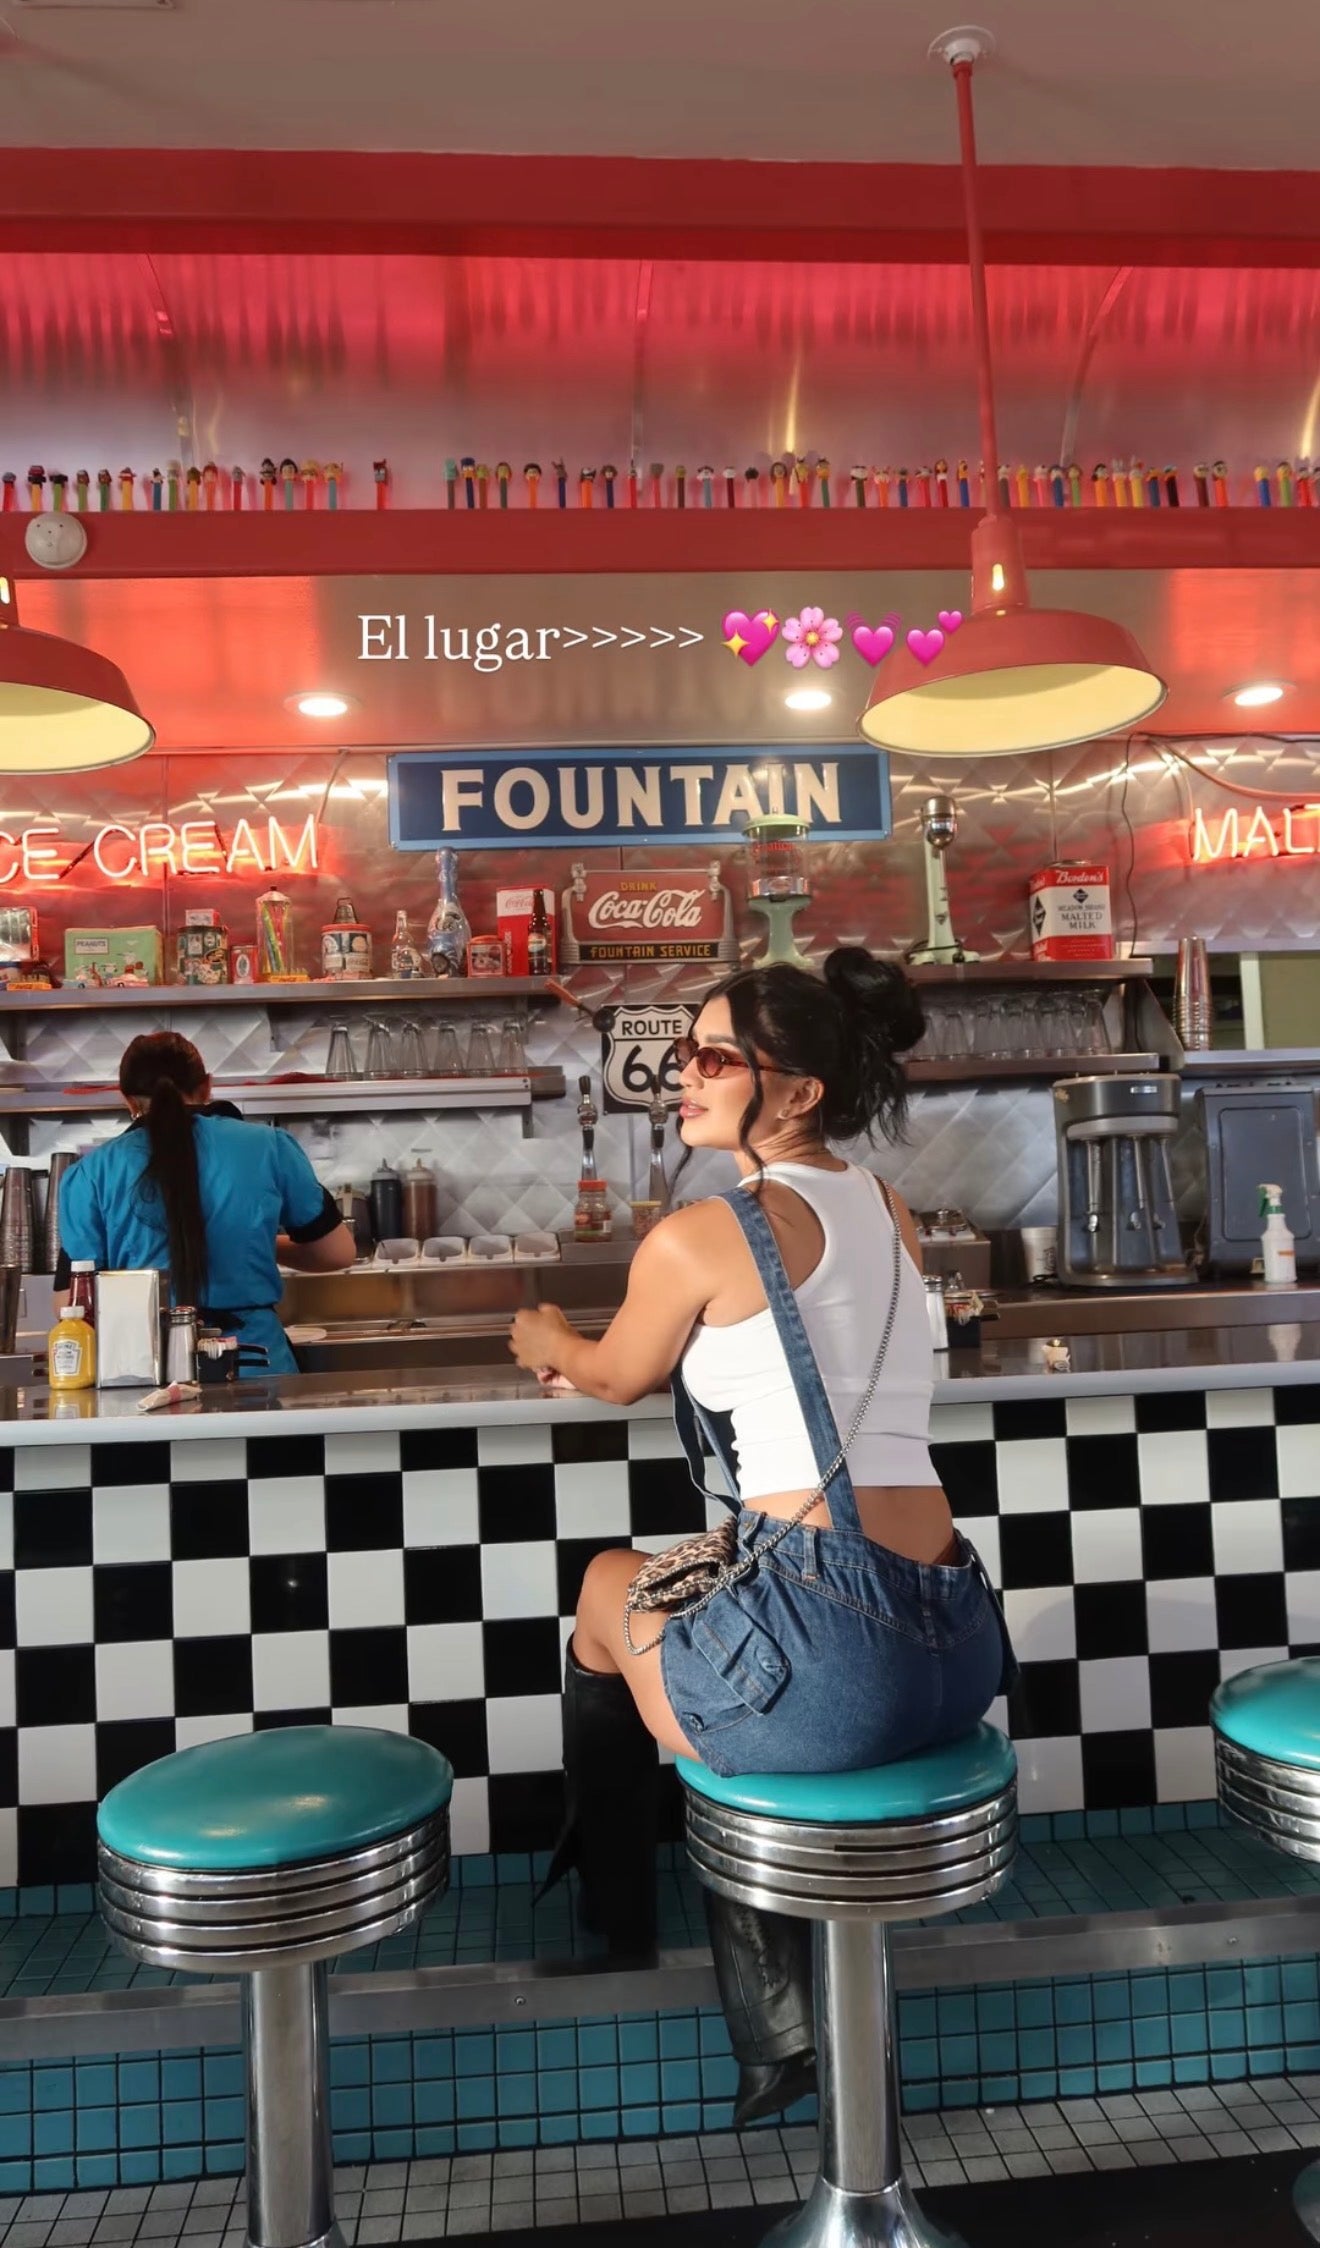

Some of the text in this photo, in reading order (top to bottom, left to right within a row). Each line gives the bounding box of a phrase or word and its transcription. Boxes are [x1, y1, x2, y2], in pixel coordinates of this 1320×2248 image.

[441, 763, 842, 832] FOUNTAIN
[94, 814, 318, 878] CREAM
[620, 882, 657, 892] DRINK
[588, 889, 706, 929] Coca-Cola
[1061, 912, 1103, 921] MALTED
[1069, 921, 1096, 929] MILK
[591, 944, 711, 958] FOUNTAIN SERVICE
[622, 1020, 682, 1036] ROUTE
[622, 1044, 685, 1093] 66
